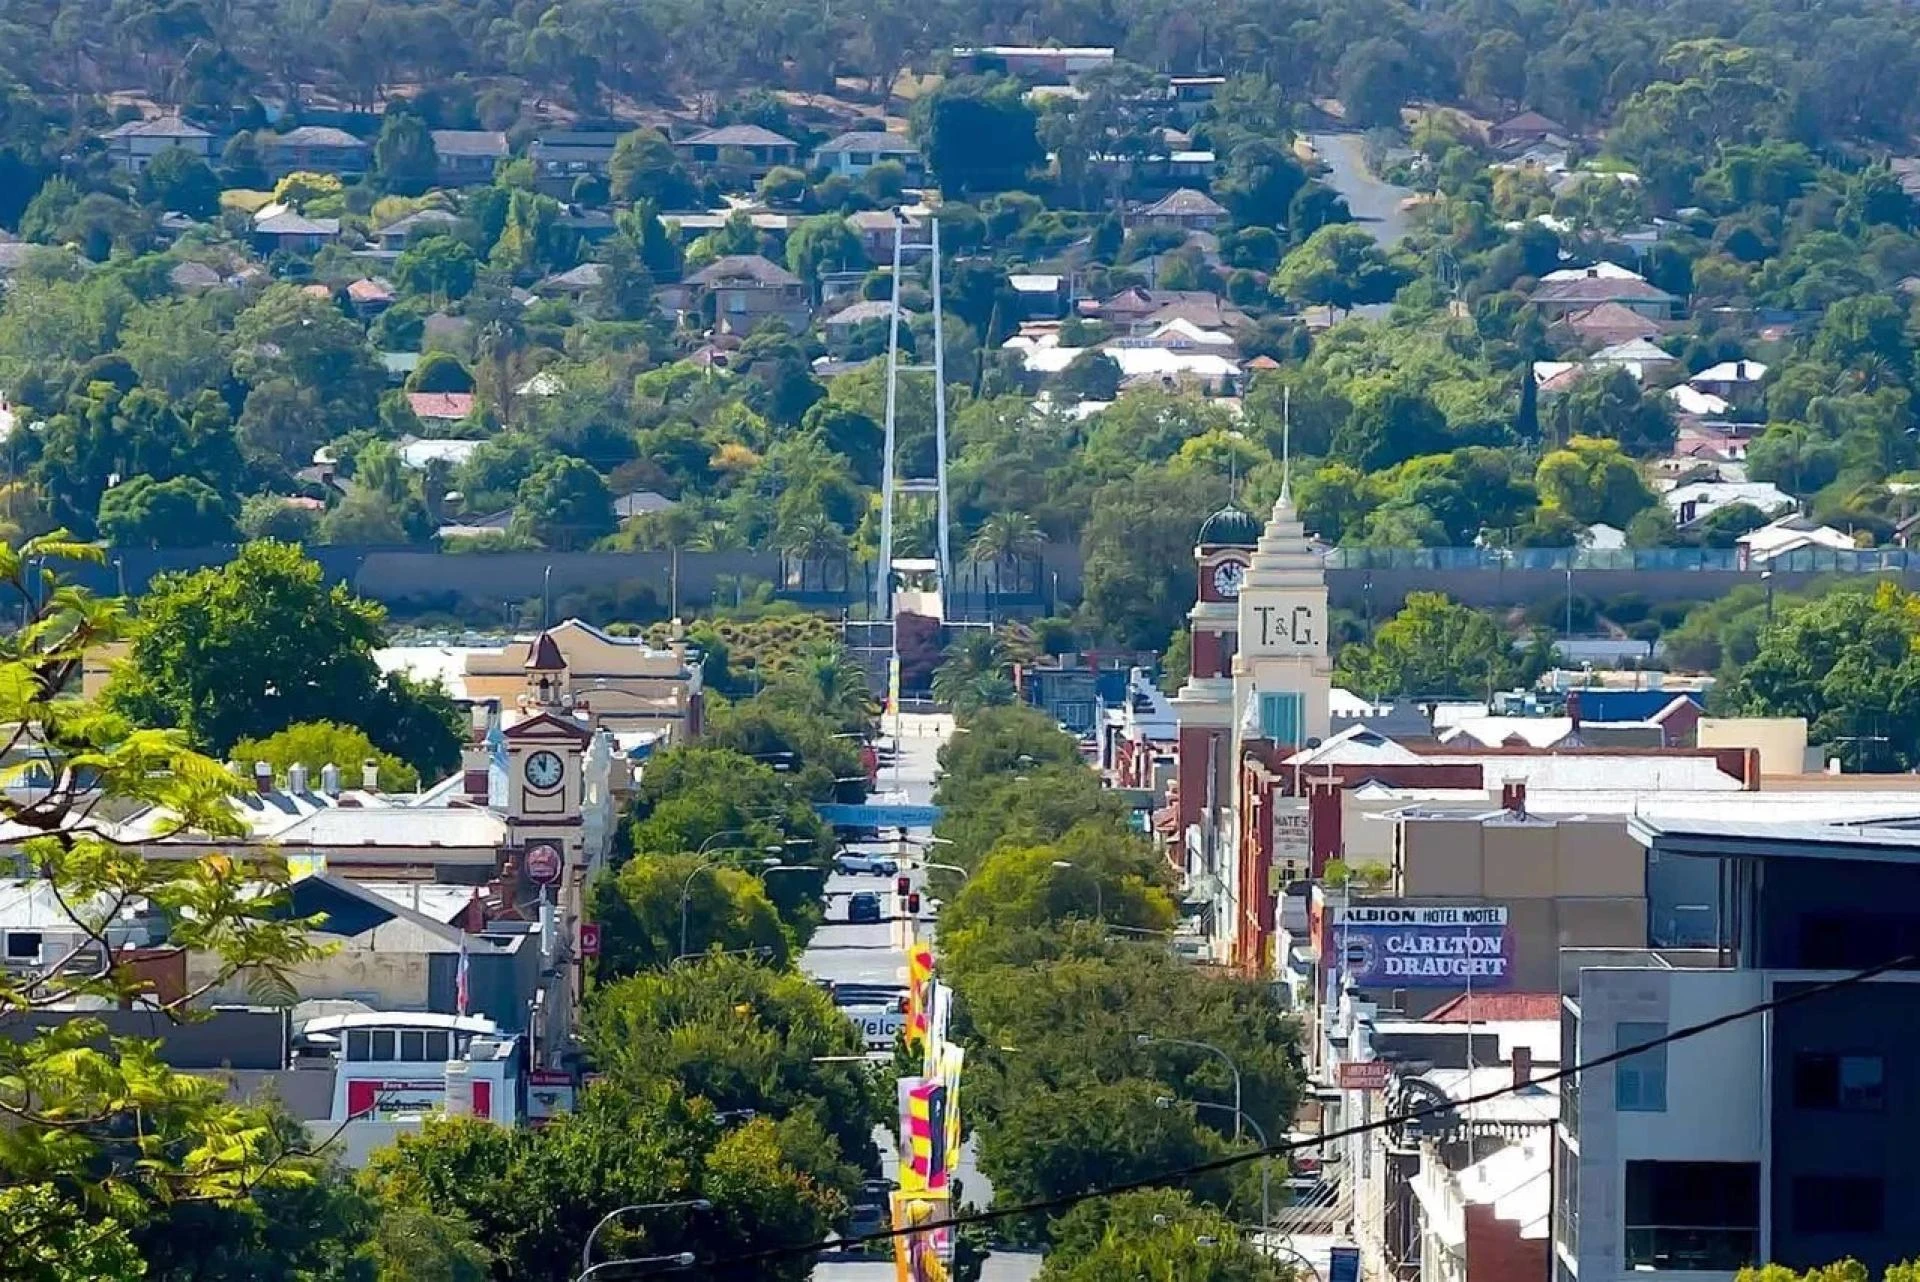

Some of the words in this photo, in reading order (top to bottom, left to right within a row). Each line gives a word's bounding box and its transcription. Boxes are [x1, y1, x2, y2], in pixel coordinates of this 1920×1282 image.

[1343, 910, 1416, 922] ALBION
[1423, 910, 1458, 922] HOTEL
[1463, 910, 1500, 922] MOTEL
[1387, 936, 1503, 954] CARLTON
[1384, 957, 1507, 976] DRAUGHT
